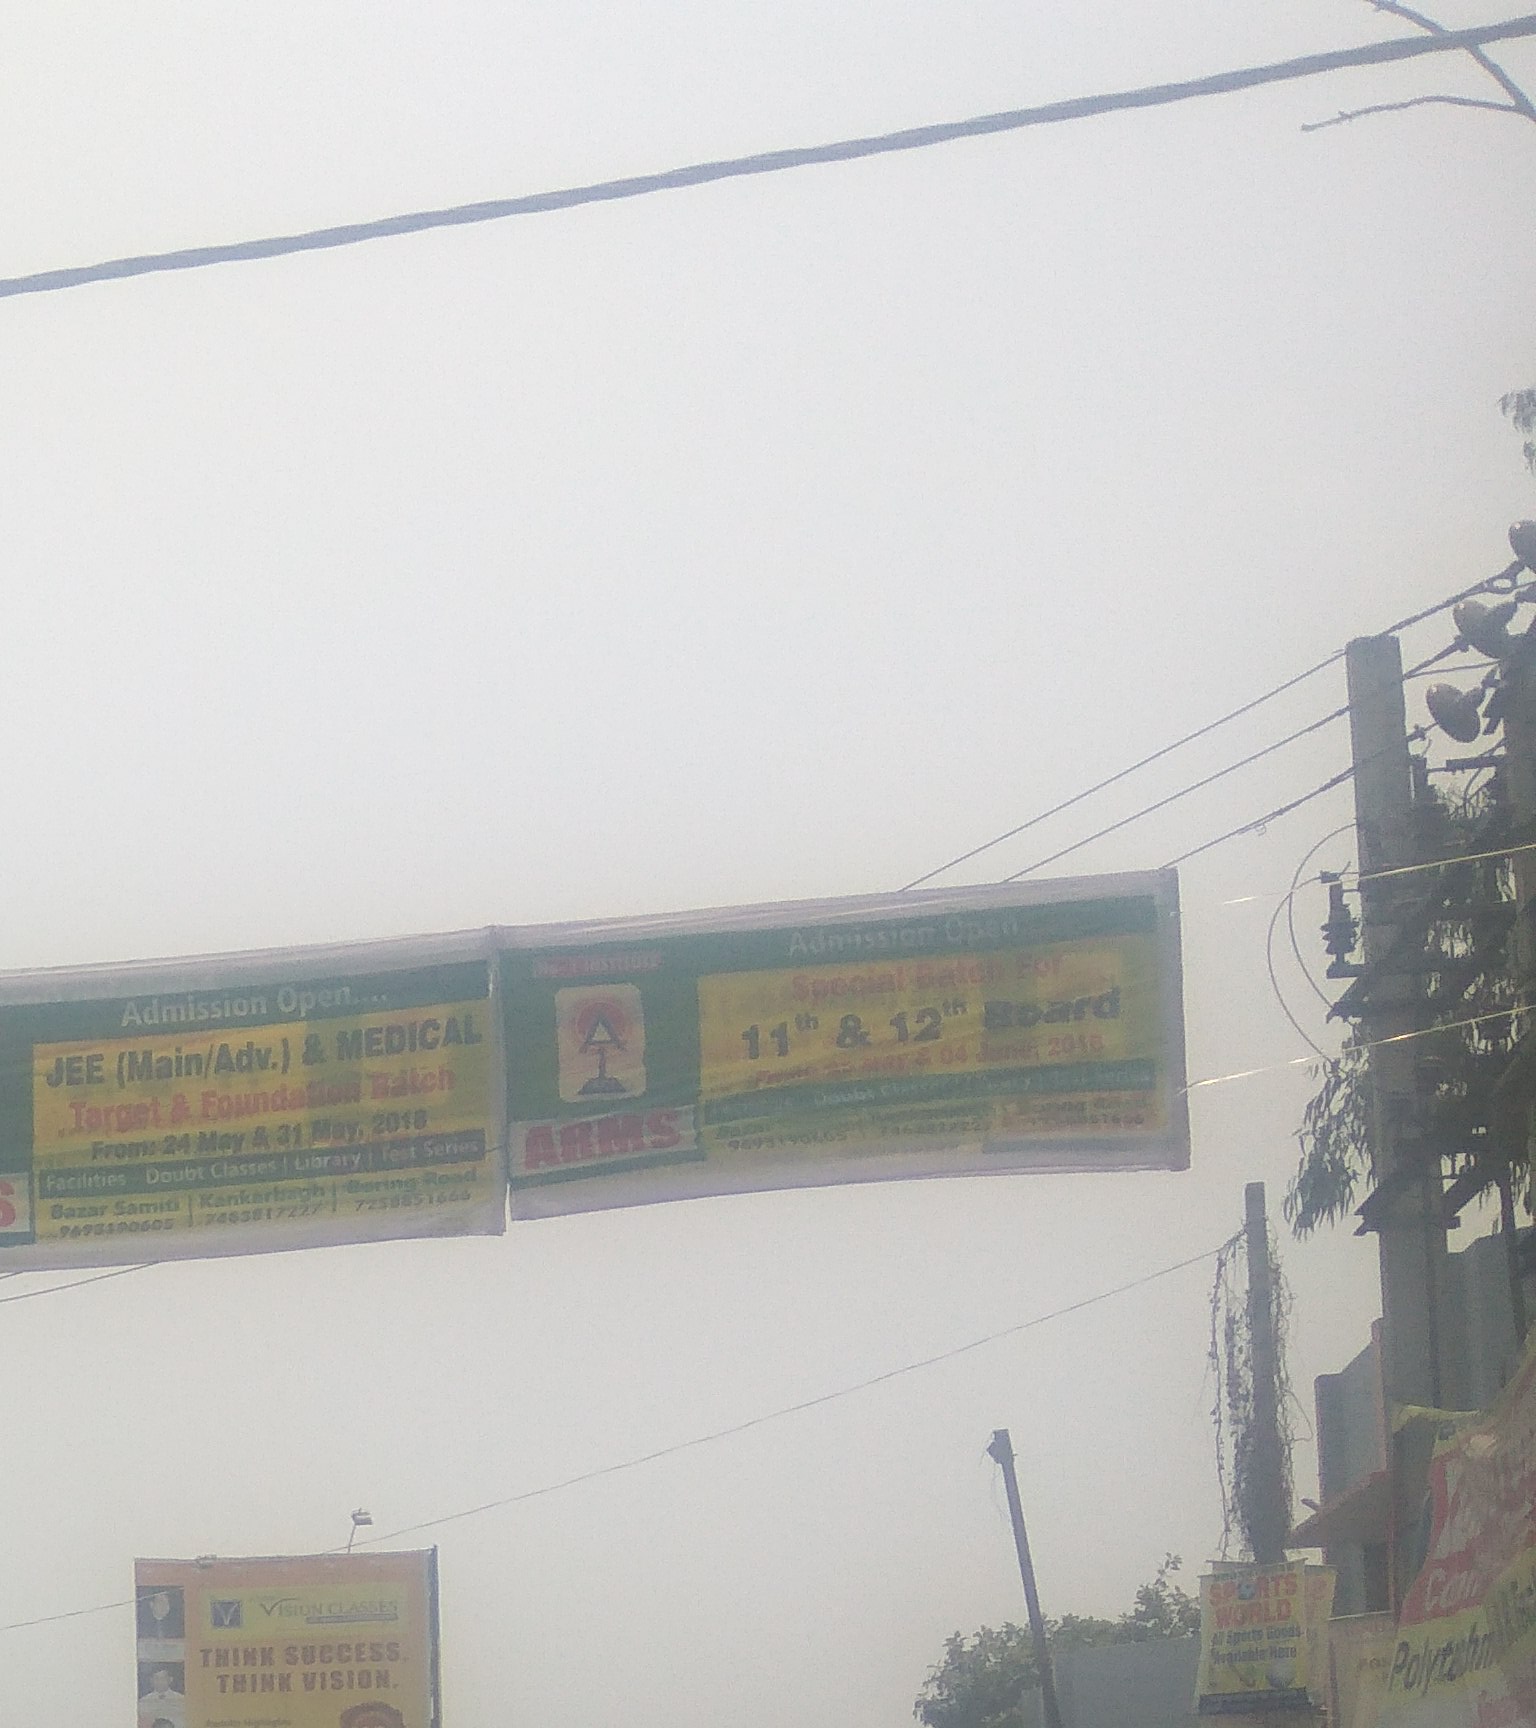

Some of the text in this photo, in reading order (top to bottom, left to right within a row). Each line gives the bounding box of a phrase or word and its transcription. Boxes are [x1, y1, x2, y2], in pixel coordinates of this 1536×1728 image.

[121, 994, 268, 1028] Admission
[741, 985, 1122, 1060] 11th & 12th Board
[45, 1013, 483, 1090] JEE (Main/Adv.) & MEDICAL
[69, 1096, 160, 1133] Target
[524, 1109, 681, 1170] ARMS
[47, 1170, 127, 1191] Facilities
[146, 1164, 205, 1184] Doubt
[210, 1158, 276, 1179] Classes
[49, 1202, 108, 1220] Bazar
[1209, 1572, 1298, 1607] SPRTS
[328, 1599, 398, 1615] CLASSES
[1215, 1598, 1292, 1629] WORLD
[199, 1641, 410, 1668] THINK SUCCESS.
[1269, 1646, 1298, 1660] Here
[215, 1669, 399, 1694] THINK VISION.
